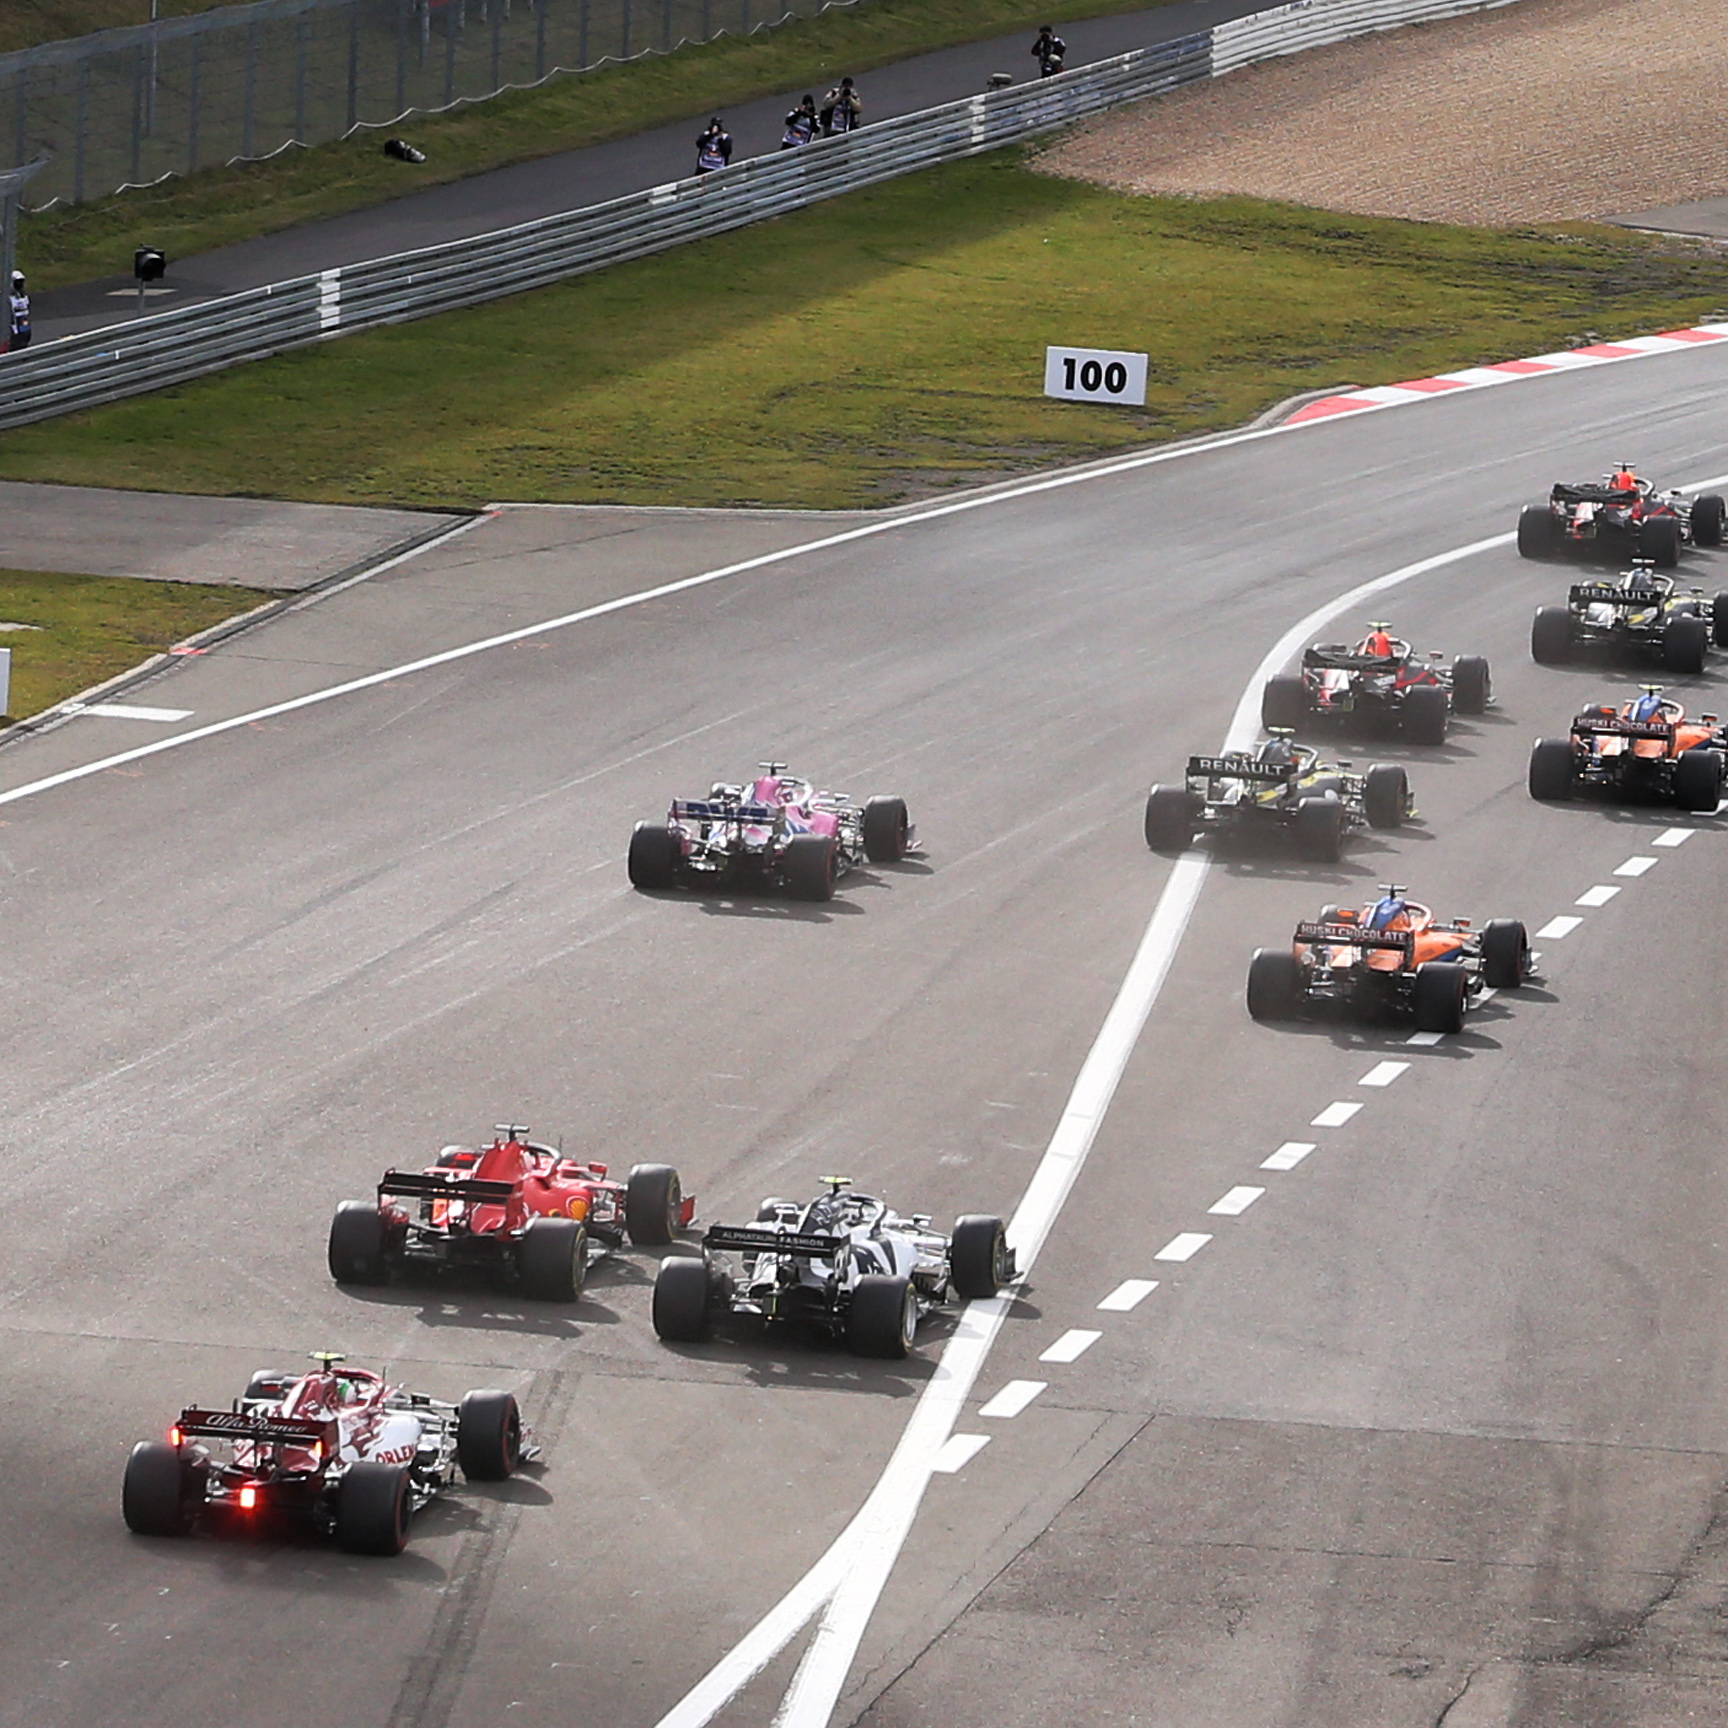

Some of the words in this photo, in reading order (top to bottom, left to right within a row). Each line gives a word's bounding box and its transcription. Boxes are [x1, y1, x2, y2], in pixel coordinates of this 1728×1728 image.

[1063, 357, 1127, 394] 100
[1579, 588, 1653, 601] RENAULT
[1610, 720, 1670, 732] CHOCOLATE
[1199, 759, 1284, 776] RENAULT
[1301, 924, 1337, 935] HUSKI
[1338, 927, 1407, 941] CHOCOLATE
[779, 1235, 825, 1247] FASHION
[205, 1414, 245, 1428] Alfa
[248, 1417, 308, 1433] Romeo
